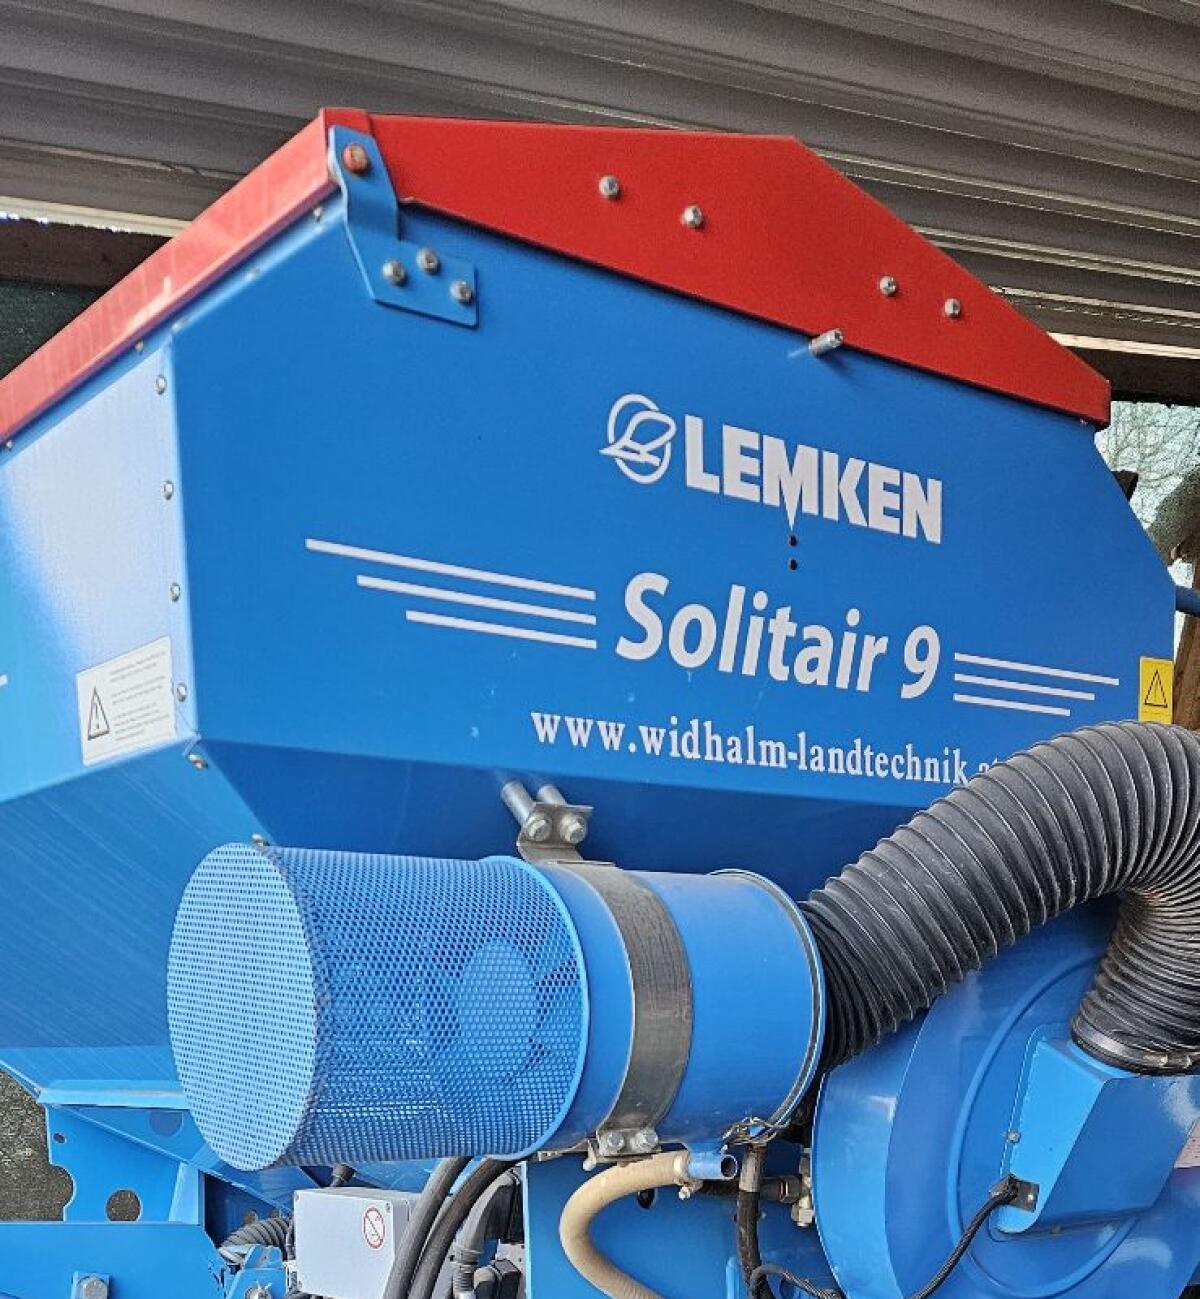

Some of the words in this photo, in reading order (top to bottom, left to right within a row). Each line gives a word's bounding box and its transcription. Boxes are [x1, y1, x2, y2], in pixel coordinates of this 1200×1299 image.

[685, 416, 943, 544] LEMKEN
[616, 573, 889, 692] Solitair
[901, 626, 940, 698] 9
[531, 712, 998, 786] www.widhalm-landtechnik
